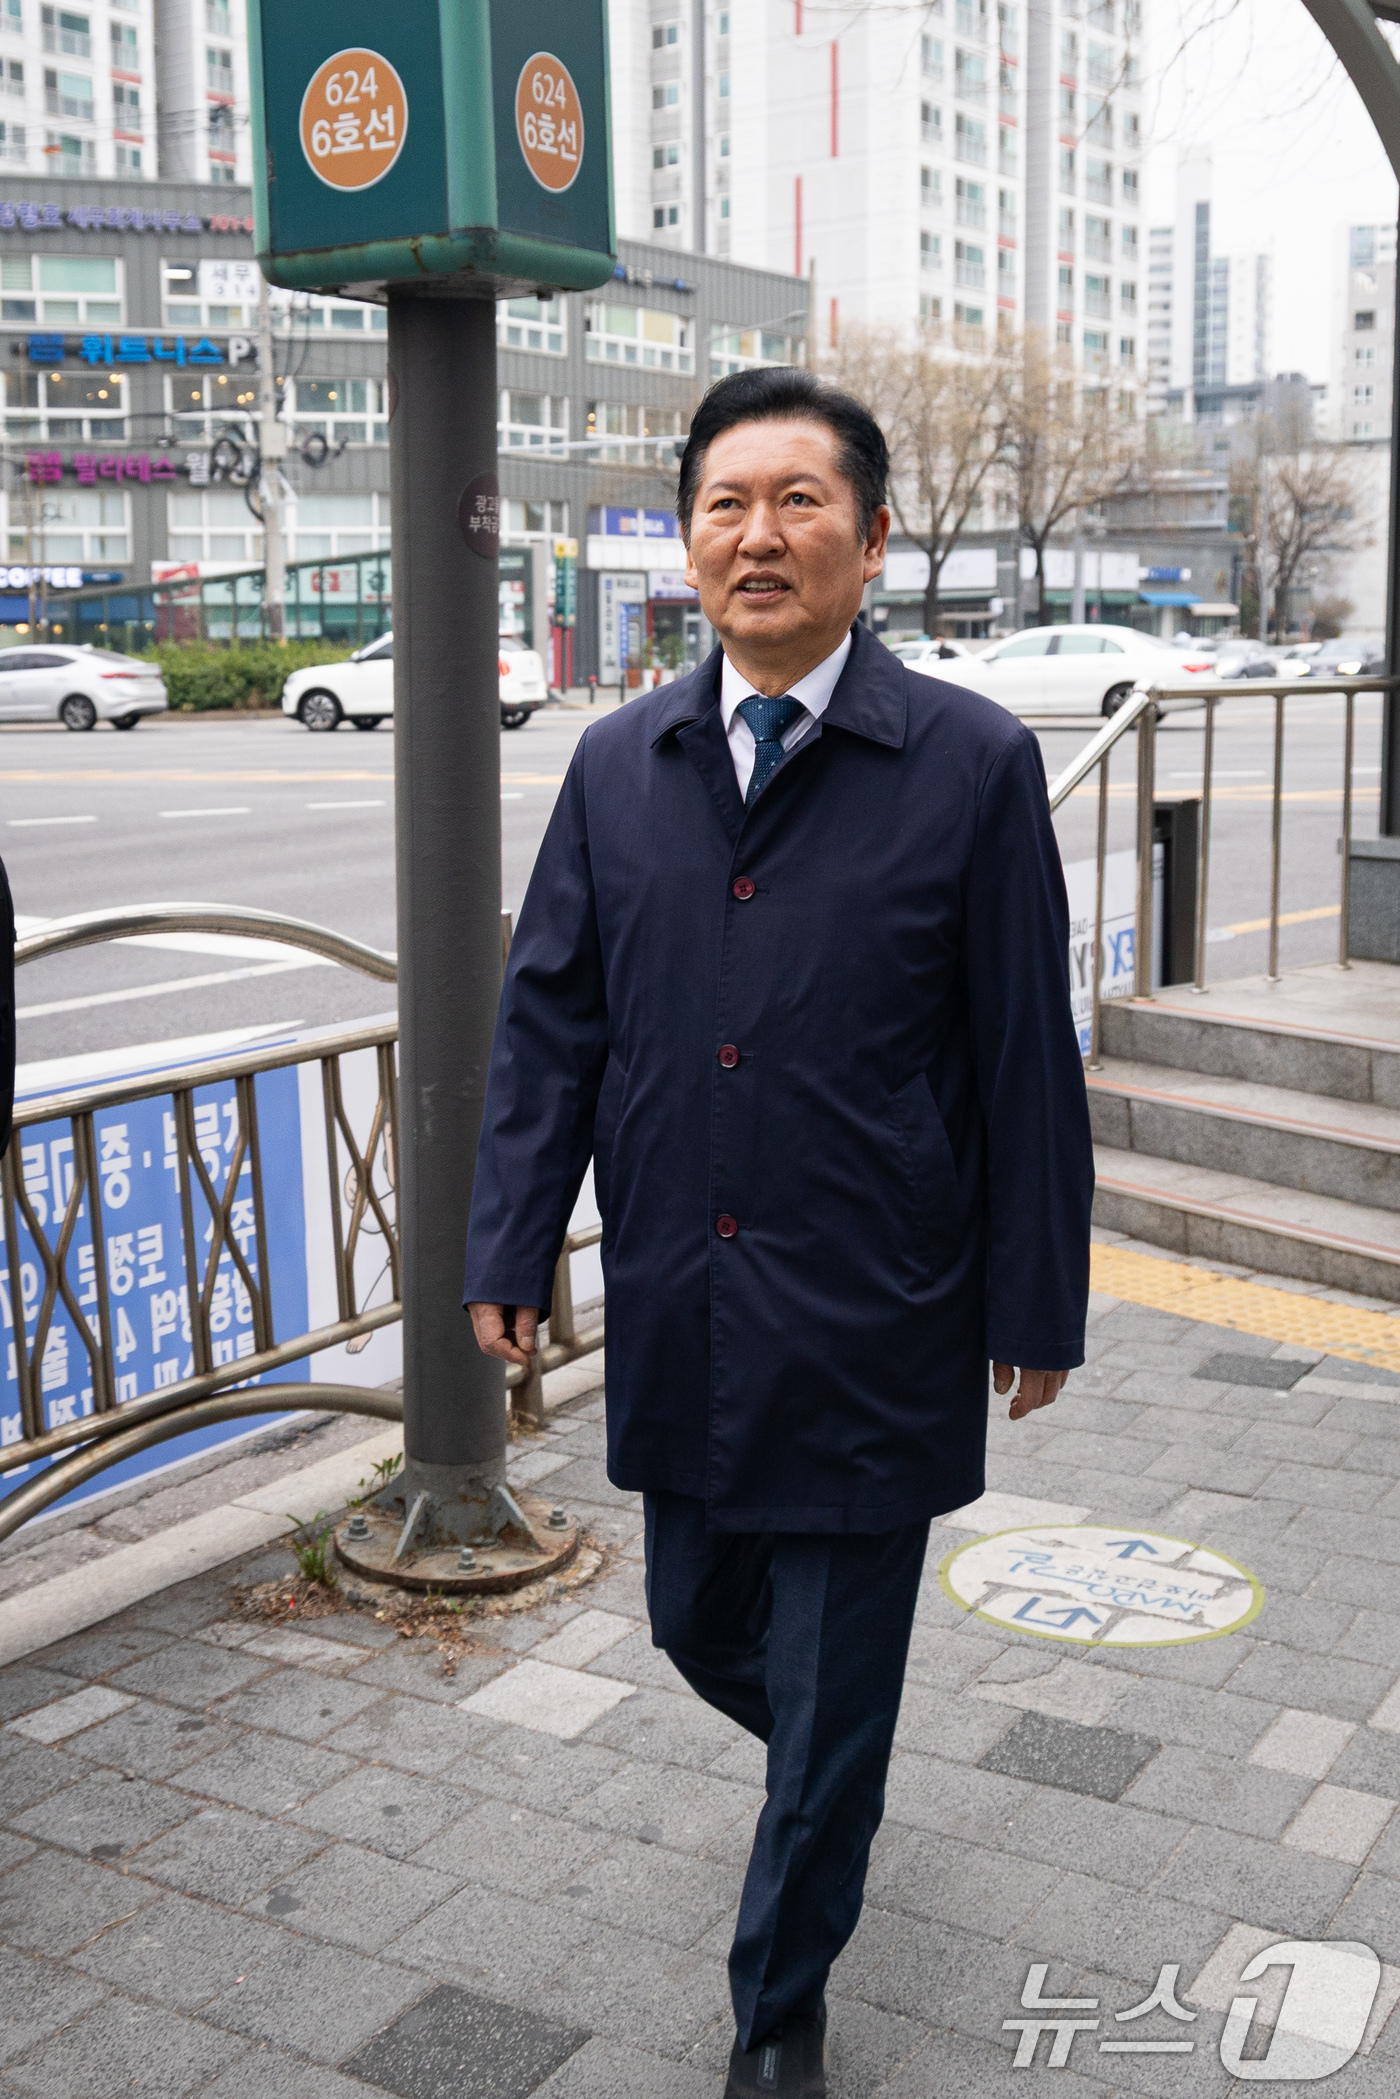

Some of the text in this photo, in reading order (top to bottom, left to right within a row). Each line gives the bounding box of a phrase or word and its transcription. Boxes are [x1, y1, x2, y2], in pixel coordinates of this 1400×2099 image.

[325, 66, 378, 107] 624
[532, 71, 567, 110] 624
[311, 104, 396, 157] 6호선
[523, 111, 578, 163] 6호선
[79, 333, 224, 367] 휘트니스
[228, 336, 263, 367] P
[72, 452, 178, 485] 필라테스
